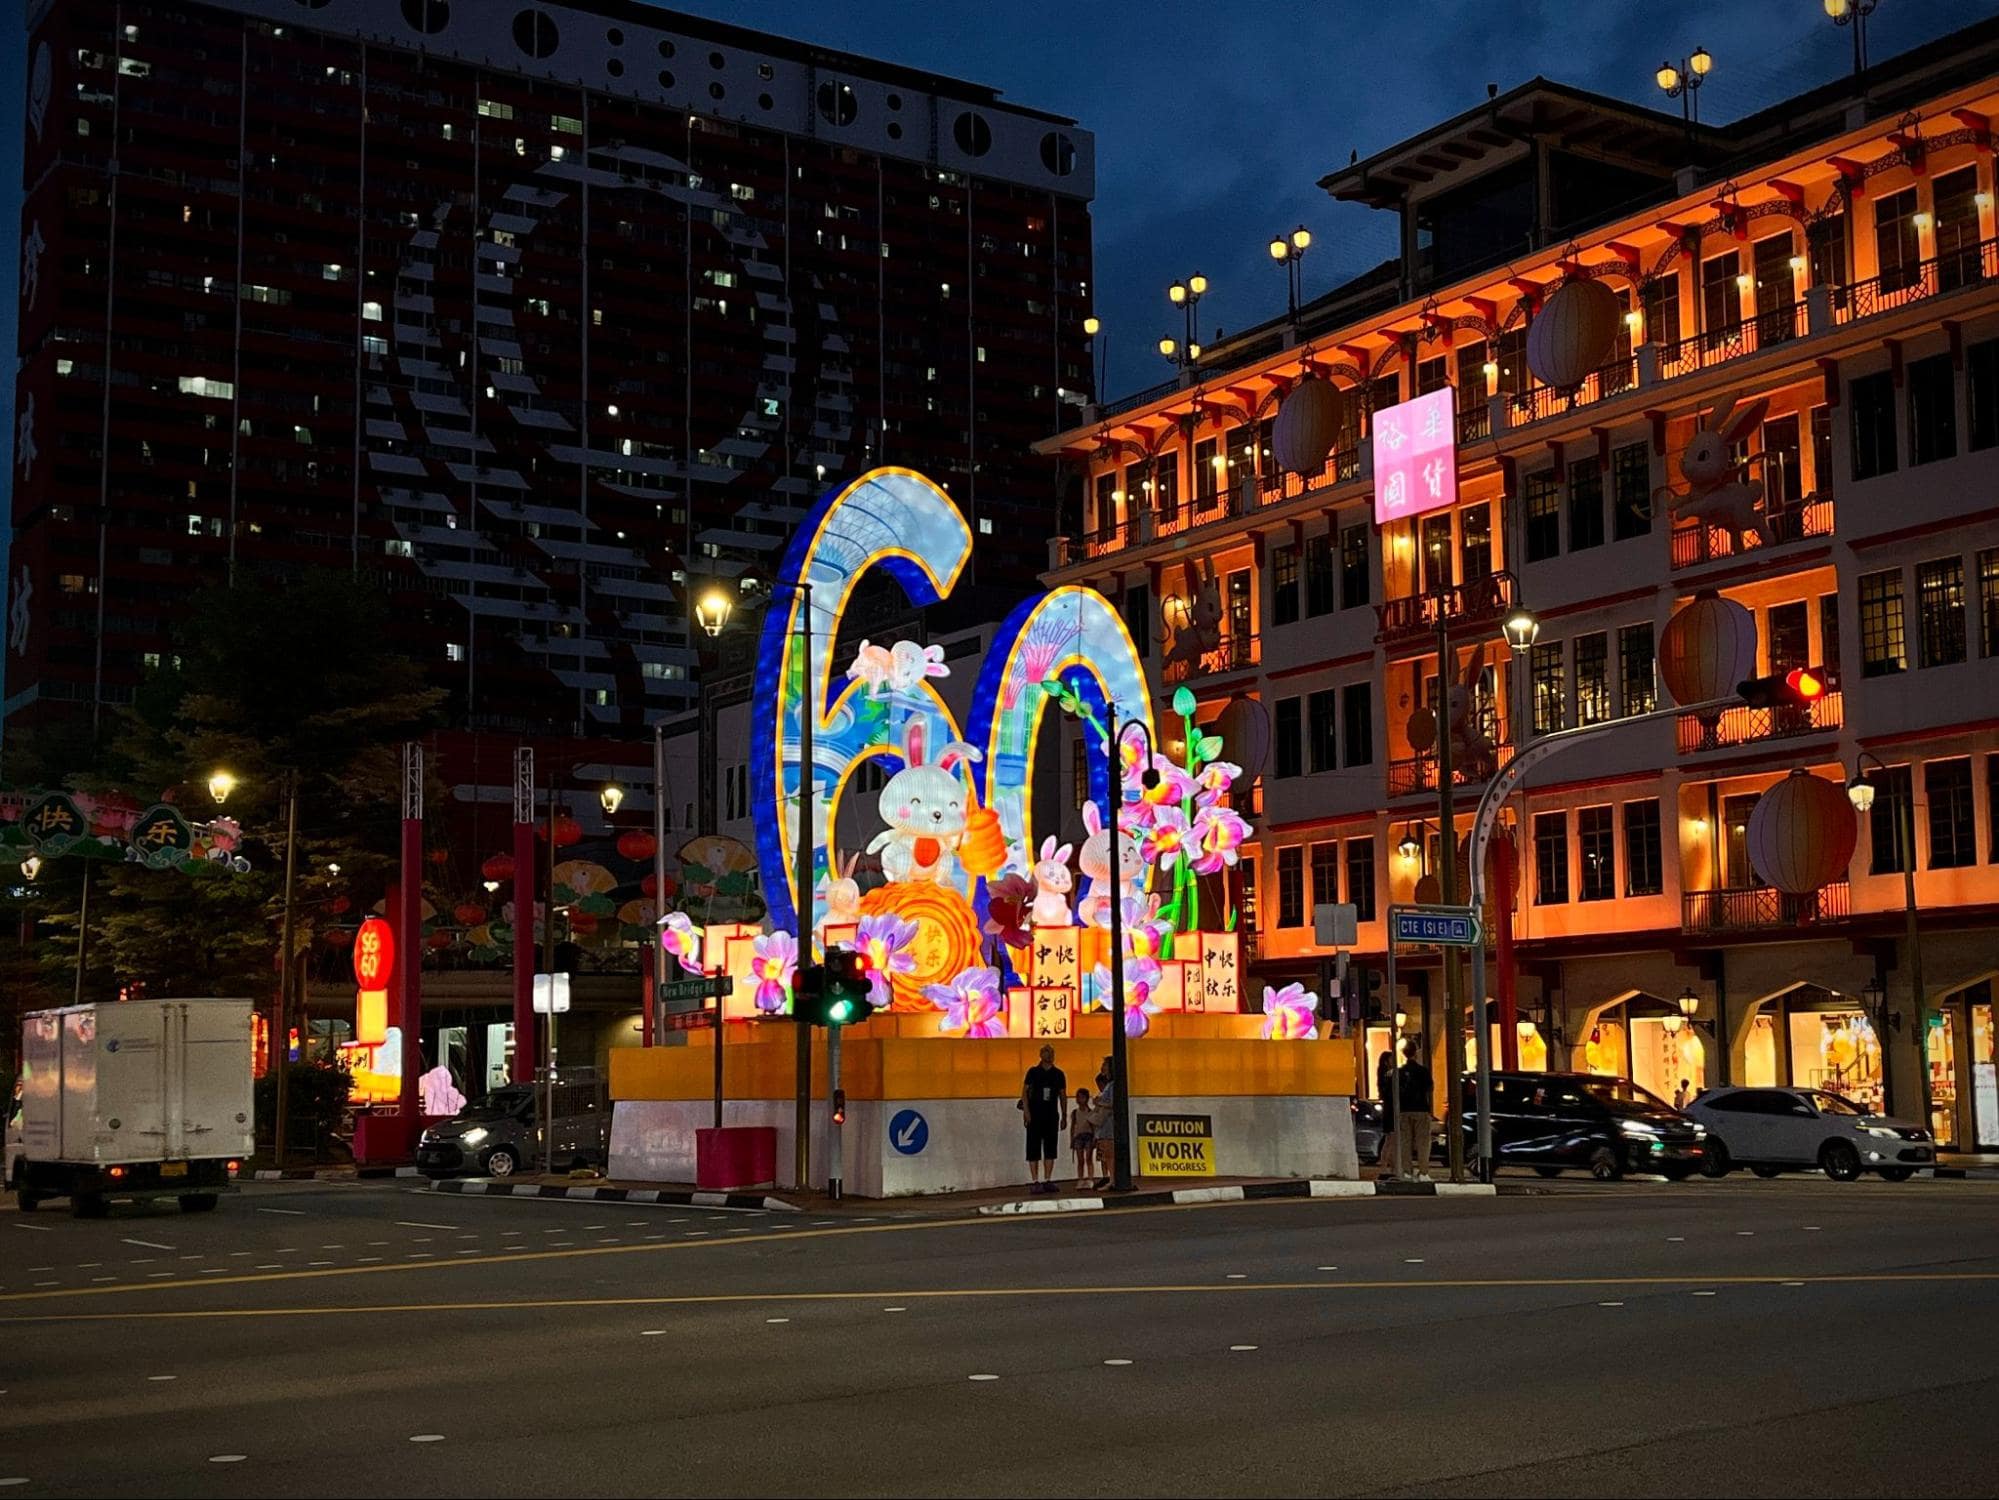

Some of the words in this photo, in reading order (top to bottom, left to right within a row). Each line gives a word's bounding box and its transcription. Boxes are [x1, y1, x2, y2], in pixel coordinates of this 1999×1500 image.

[35, 804, 74, 832] 快
[147, 819, 178, 845] 乐
[1401, 920, 1419, 934] CTE
[361, 931, 379, 953] SG
[361, 954, 378, 978] 60
[1204, 948, 1219, 997] 中秋
[1219, 949, 1237, 997] 快乐
[1146, 1121, 1204, 1134] CAUTION
[1148, 1142, 1205, 1160] WORK
[1149, 1162, 1159, 1171] IN
[1161, 1162, 1206, 1171] PROGRESS
